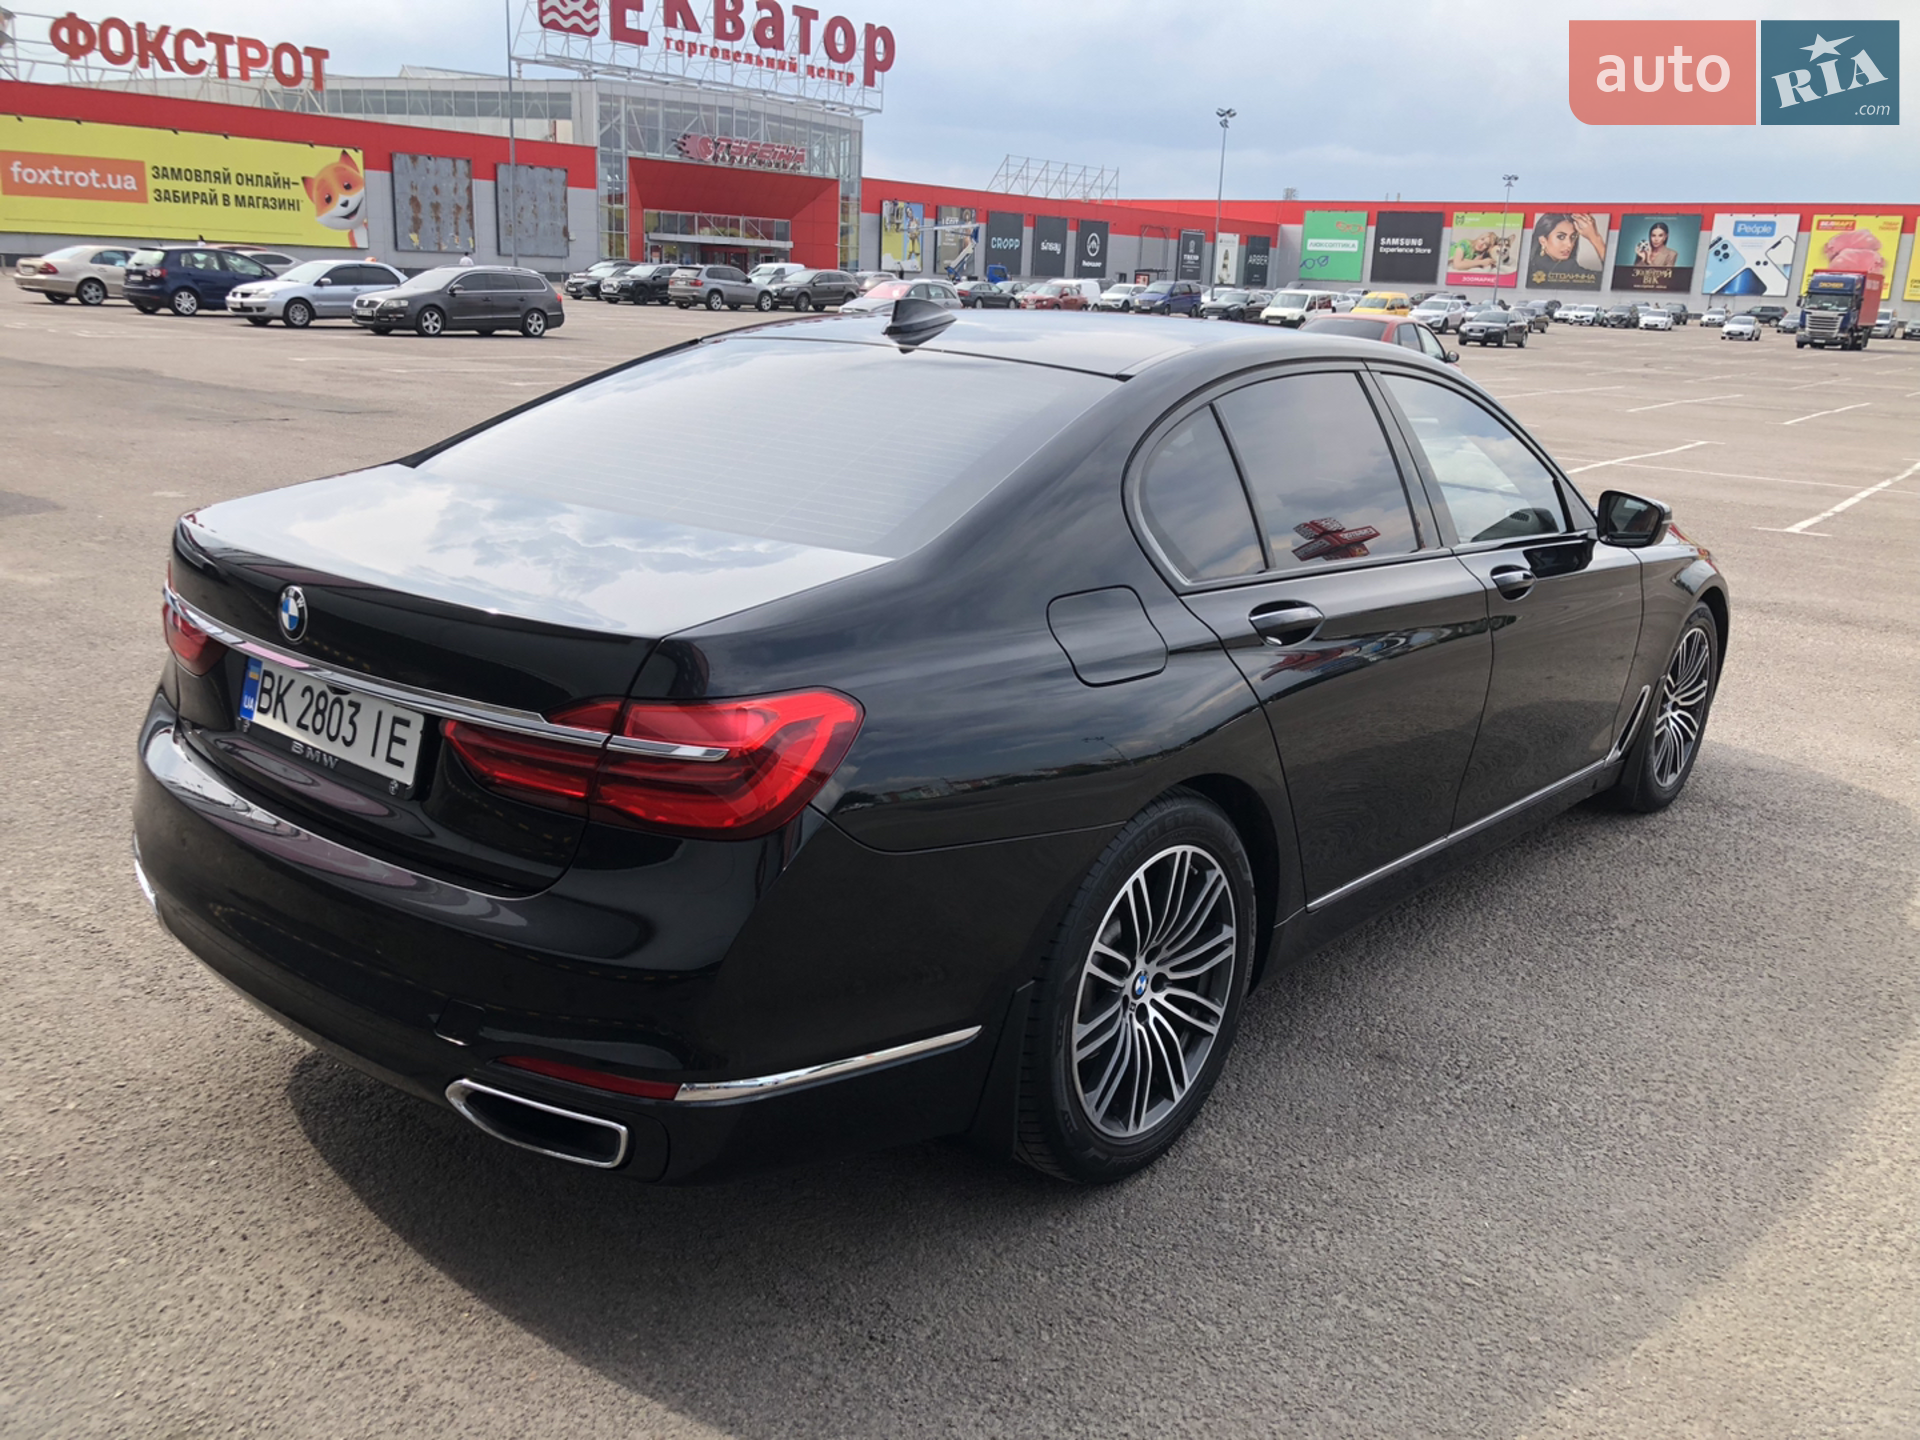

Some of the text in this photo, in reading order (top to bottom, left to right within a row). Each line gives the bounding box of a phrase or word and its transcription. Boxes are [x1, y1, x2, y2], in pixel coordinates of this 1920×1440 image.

[49, 12, 330, 91] ФОКСТРОТ
[664, 37, 856, 87] торговельний центр
[10, 160, 138, 191] foxtrot.ua
[151, 165, 232, 186] ЗАМОВЛЯЙ
[153, 188, 219, 208] ЗАБИРАЙ
[222, 194, 231, 208] В
[991, 236, 1021, 250] CROPP
[1040, 239, 1062, 255] sinsay
[1379, 246, 1414, 255] Experience
[1380, 237, 1424, 246] SAMSUNG
[243, 696, 254, 711] UA
[257, 670, 412, 769] BK 2803 IE
[290, 740, 340, 769] BMW
